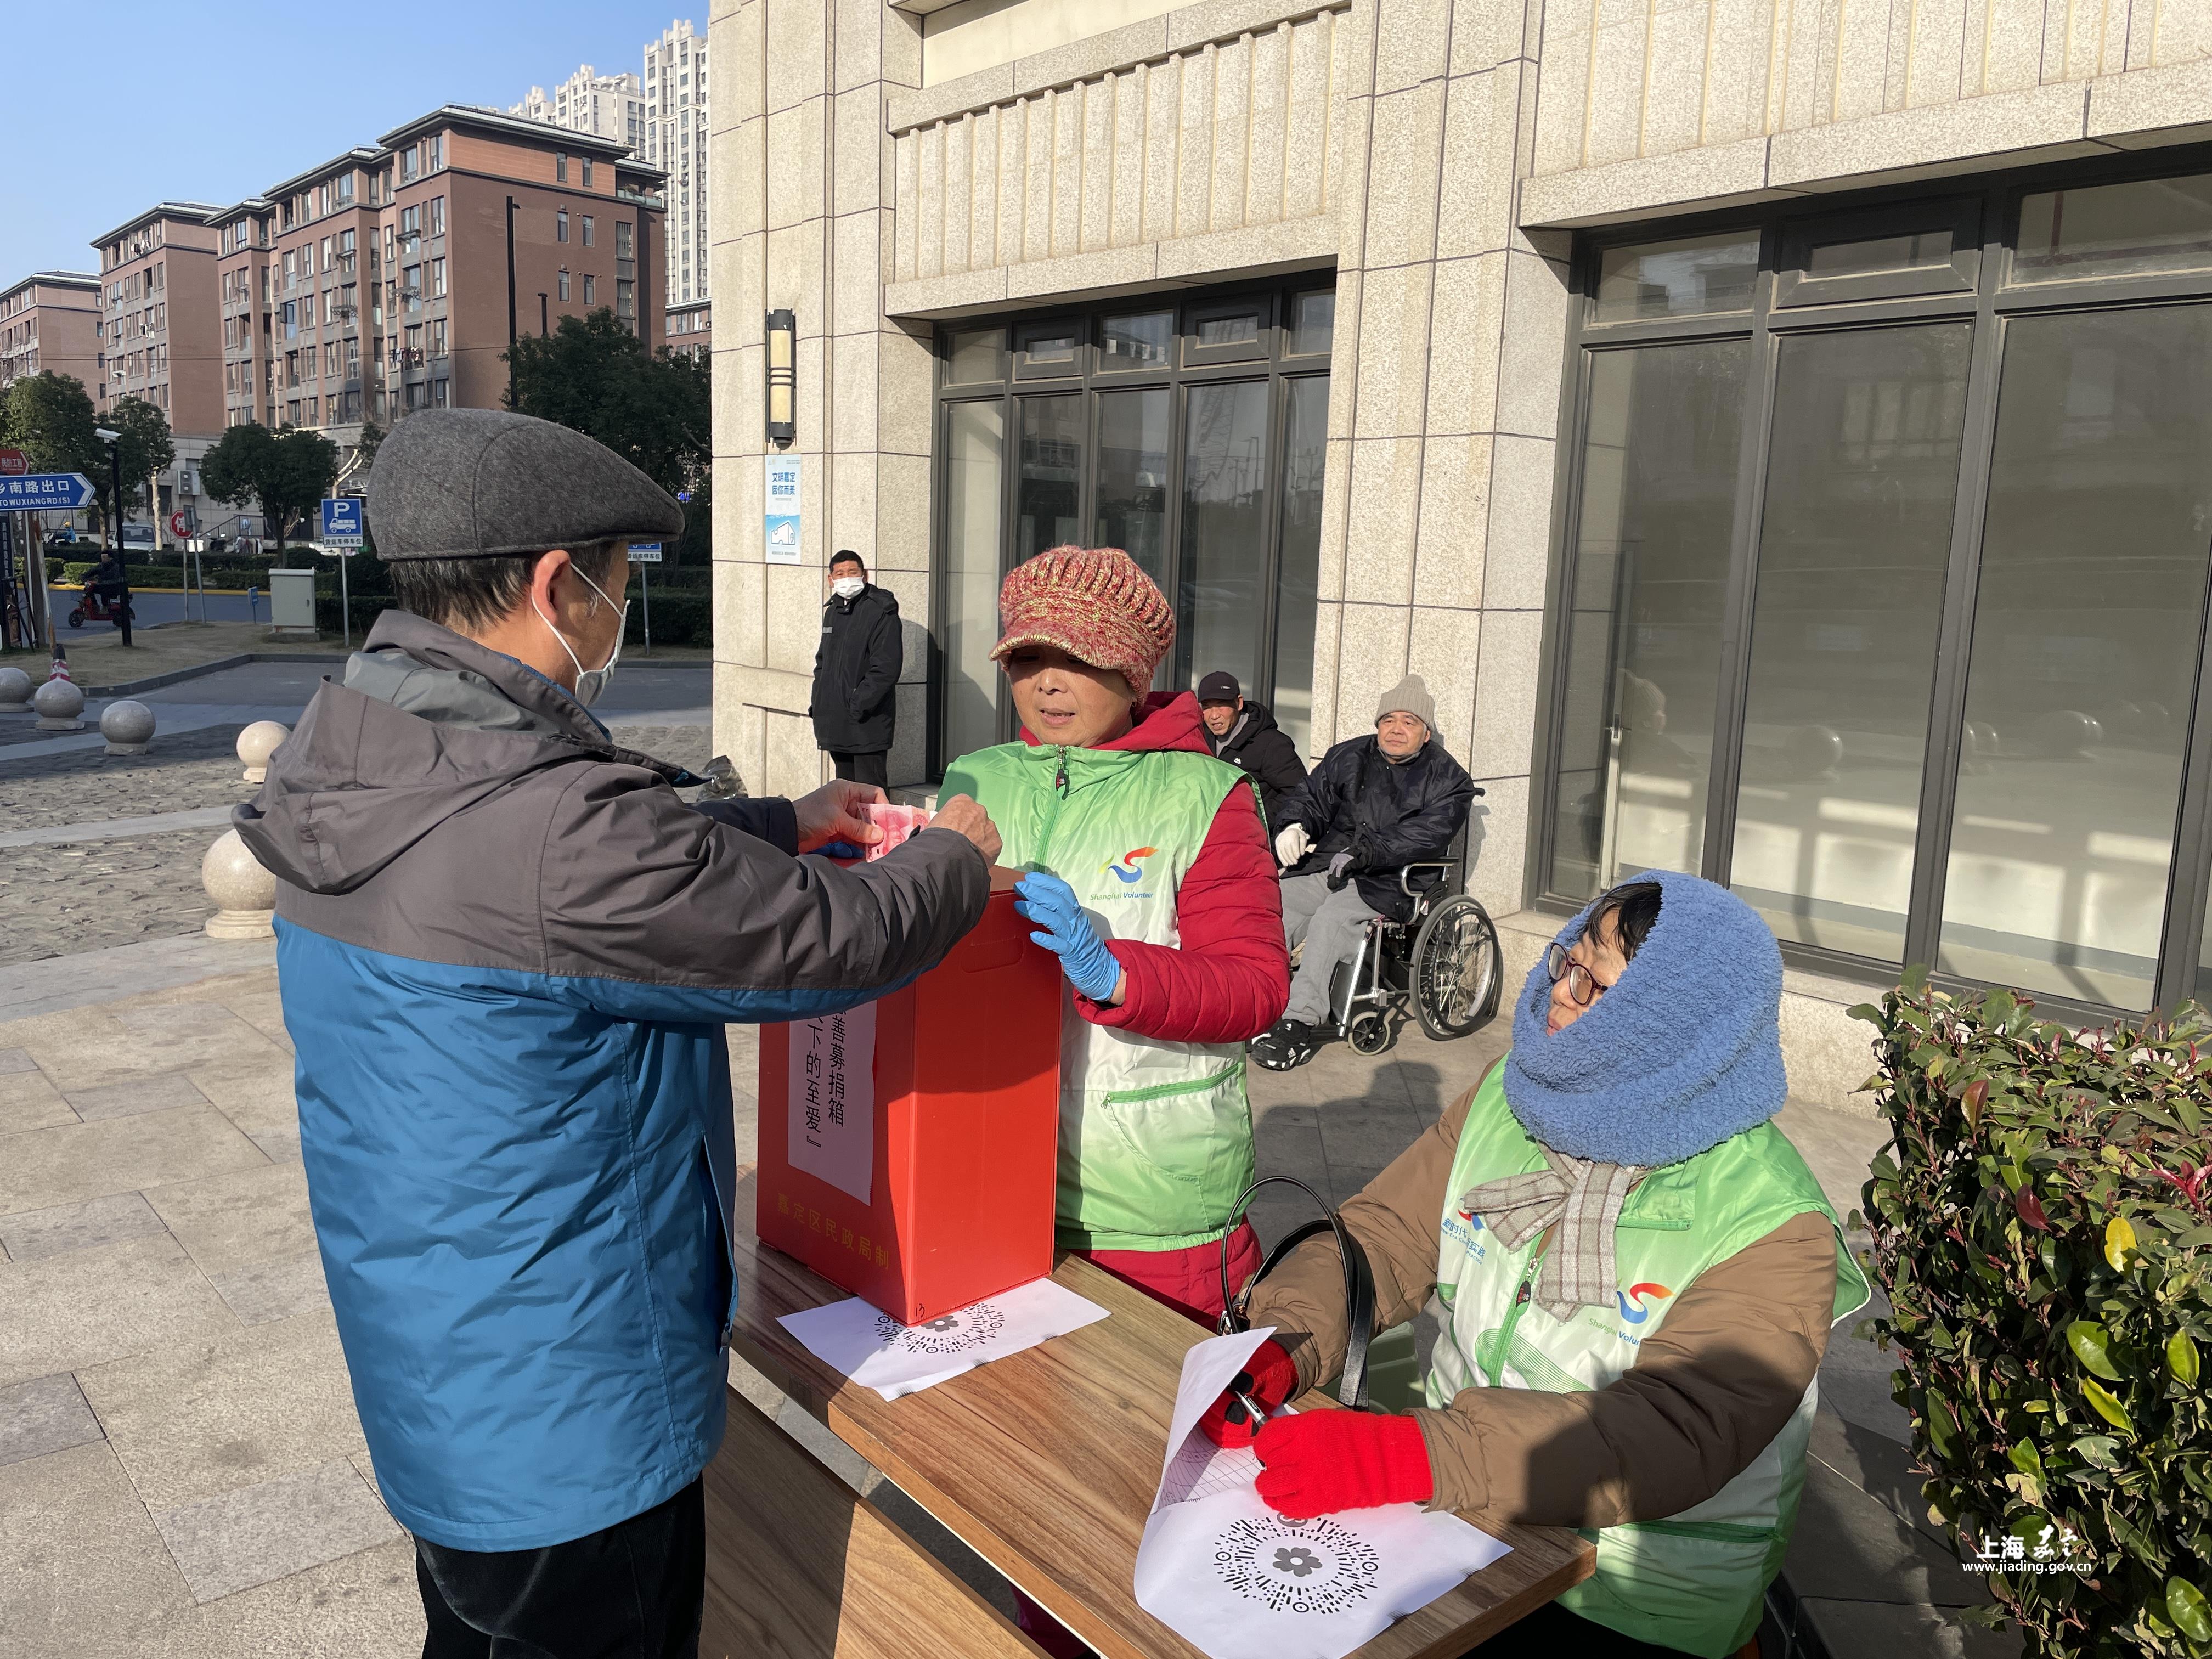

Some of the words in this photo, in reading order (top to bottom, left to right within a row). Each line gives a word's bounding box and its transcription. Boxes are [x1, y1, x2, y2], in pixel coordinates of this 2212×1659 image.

[334, 502, 351, 517] P
[772, 485, 795, 495] 因你而美
[1090, 893, 1122, 901] Shanghai
[805, 1017, 823, 1148] 下的至爱』
[828, 1011, 847, 1128] 善募捐箱
[777, 1192, 889, 1270] 嘉定区民政局制
